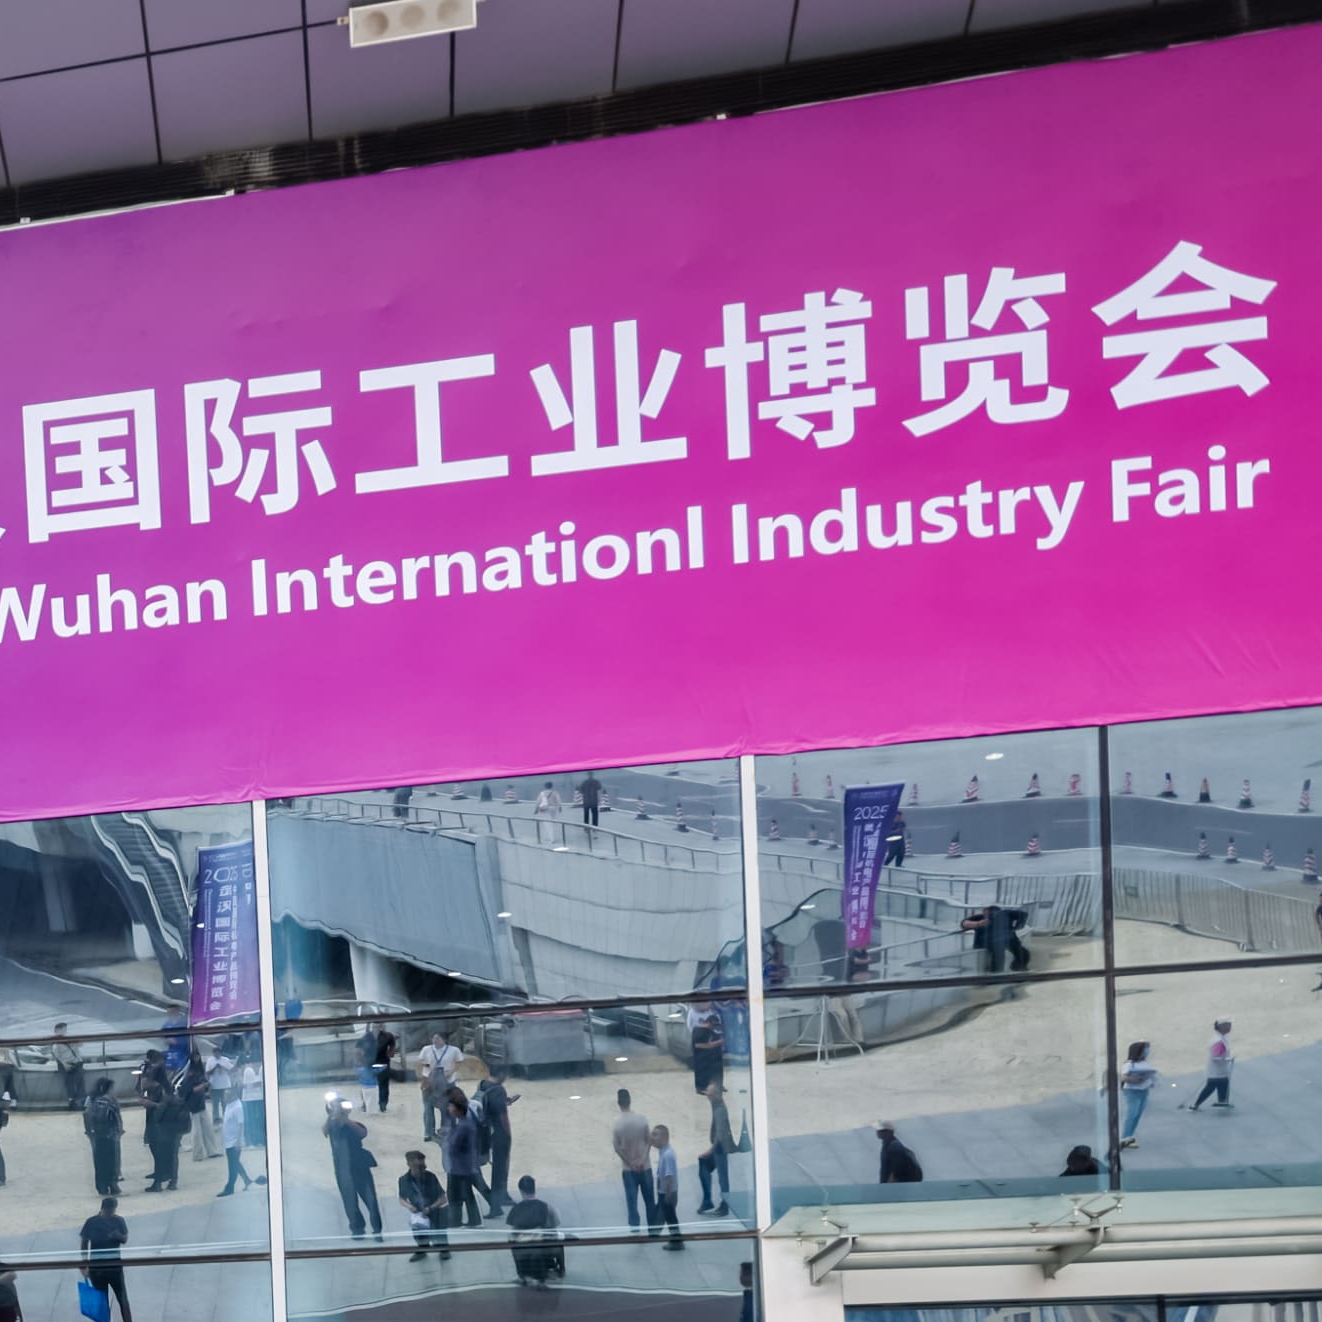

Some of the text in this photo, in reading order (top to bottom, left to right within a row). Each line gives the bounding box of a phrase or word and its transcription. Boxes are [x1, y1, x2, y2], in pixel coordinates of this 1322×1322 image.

[251, 505, 705, 616] Internationl
[732, 480, 1085, 564] Industry
[1111, 445, 1271, 522] Fair
